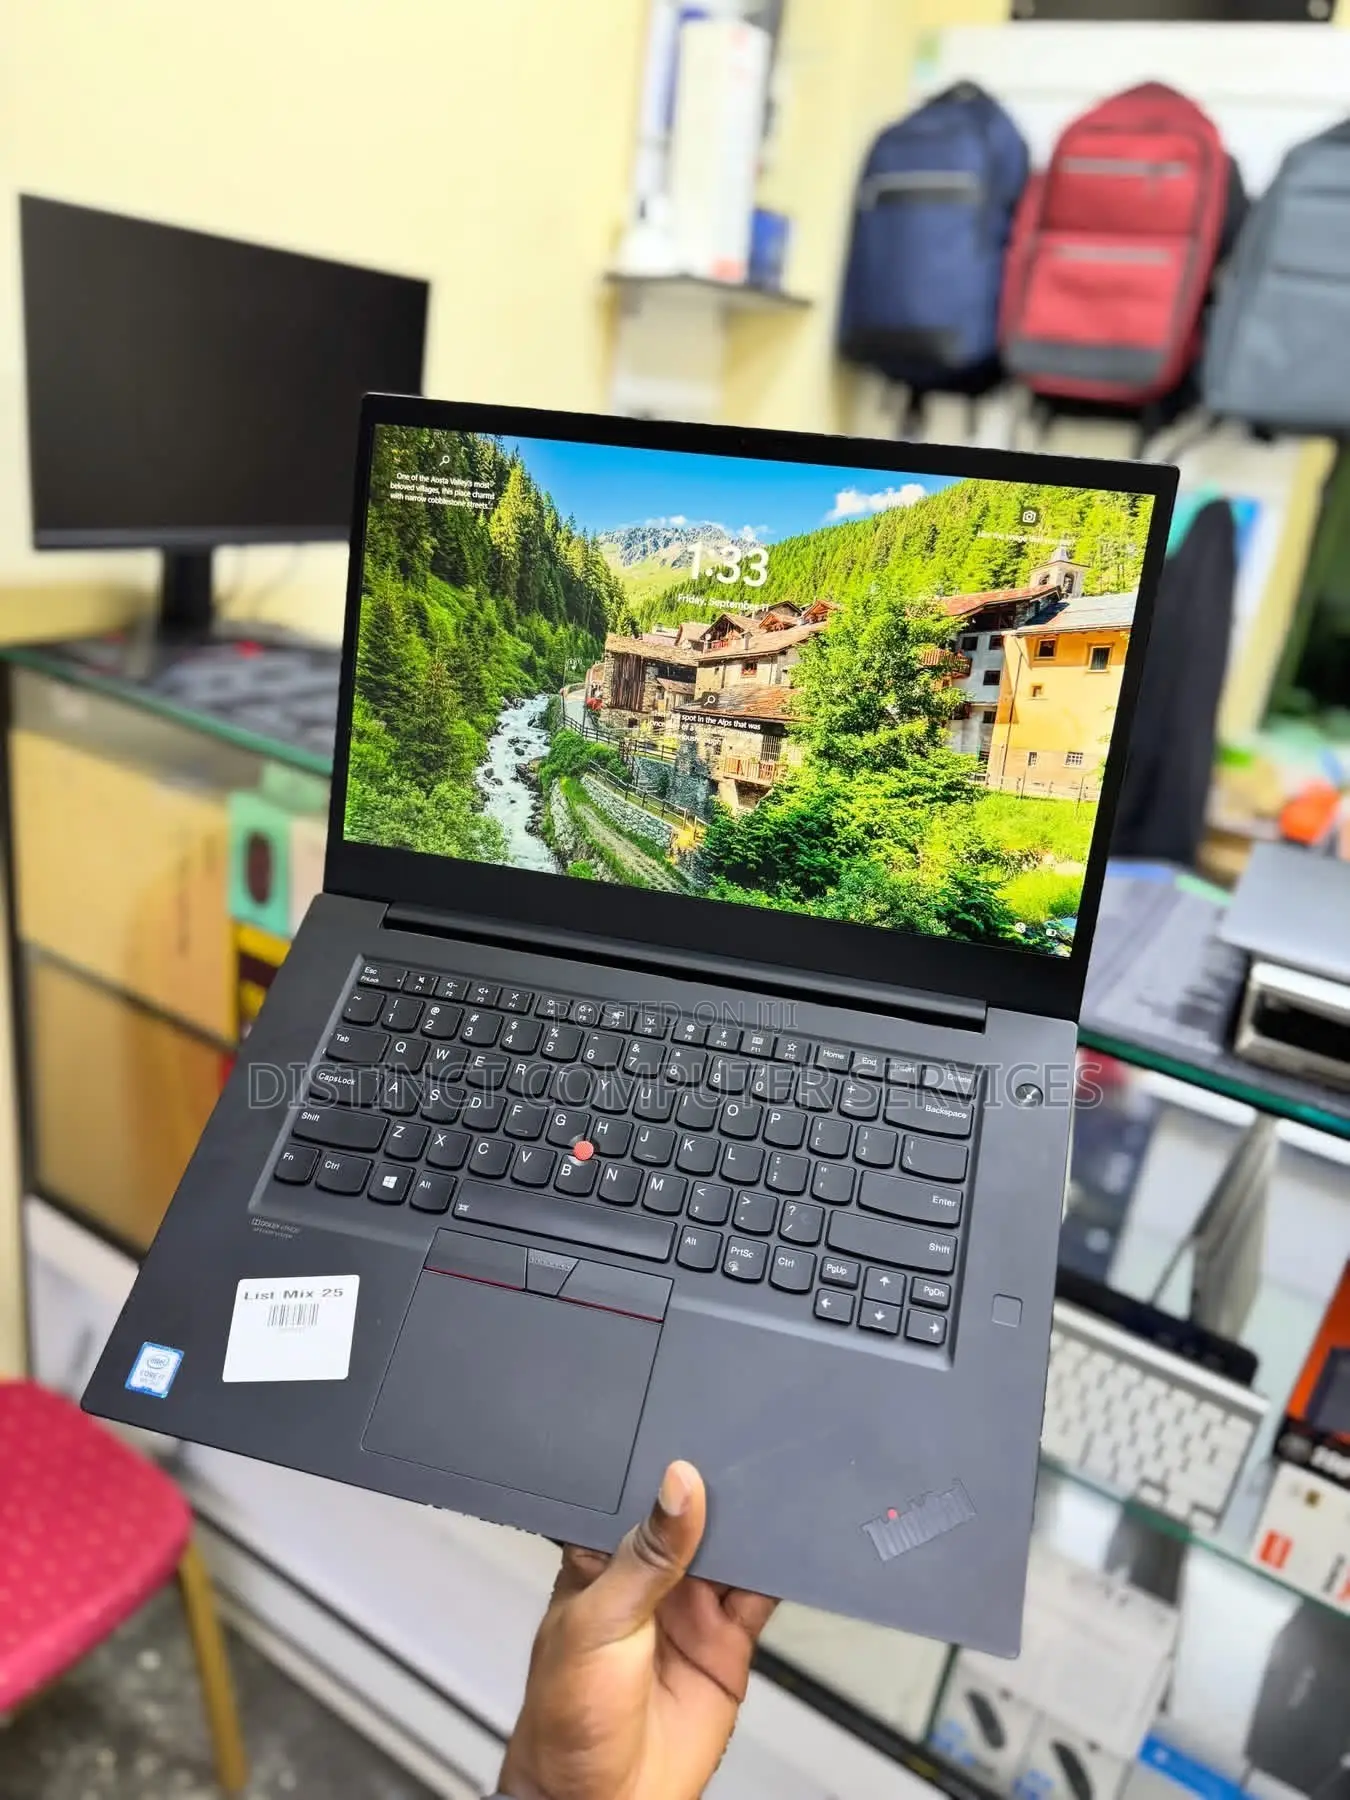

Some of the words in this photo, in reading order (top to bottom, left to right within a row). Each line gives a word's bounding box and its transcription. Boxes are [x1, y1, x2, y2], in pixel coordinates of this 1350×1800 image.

[397, 472, 410, 480] One
[419, 474, 429, 482] the
[431, 476, 448, 484] Aosta
[390, 482, 414, 491] beloved
[442, 487, 453, 495] this
[454, 489, 471, 498] place
[390, 492, 404, 500] with
[405, 494, 427, 502] narrow
[428, 496, 465, 507] cobblestone
[681, 714, 696, 722] spot
[705, 716, 717, 725] the
[717, 718, 732, 727] Alps
[733, 720, 747, 729] that
[364, 966, 377, 975] Esc
[424, 1019, 434, 1030] 2
[336, 1033, 350, 1043] Tab
[465, 1027, 473, 1037] 3
[505, 1034, 513, 1044] 4
[395, 1041, 407, 1053] Q
[546, 1041, 554, 1052] 5
[436, 1048, 450, 1060] W
[586, 1049, 596, 1060] 6
[822, 1050, 845, 1060] Home
[474, 1056, 486, 1067] E
[628, 1056, 637, 1067] 7
[862, 1057, 877, 1066] End
[515, 1063, 527, 1075] R
[669, 1065, 678, 1076] 8
[318, 1072, 356, 1086] CapsLock
[558, 1070, 568, 1082] T
[712, 1073, 721, 1084] 9
[388, 1081, 398, 1094] A
[600, 1079, 610, 1091] Y
[755, 1081, 763, 1092] 0
[430, 1089, 440, 1101] S
[641, 1087, 651, 1100] U
[470, 1096, 482, 1109] D
[512, 1104, 523, 1116] F
[727, 1104, 739, 1117] O
[925, 1104, 968, 1119] Backspace
[301, 1111, 320, 1122] Shift
[555, 1113, 567, 1126] G
[770, 1112, 781, 1124] P
[392, 1125, 406, 1138] Z
[597, 1121, 609, 1135] H
[434, 1133, 447, 1147] X
[640, 1130, 649, 1143] J
[477, 1142, 489, 1155] C
[683, 1138, 695, 1152] K
[283, 1152, 294, 1161] Fn
[522, 1150, 532, 1163] V
[727, 1147, 736, 1161] L
[324, 1160, 340, 1171] Ctrl
[561, 1163, 572, 1176] B
[606, 1167, 618, 1181] N
[419, 1179, 431, 1189] Alt
[650, 1177, 665, 1192] M
[932, 1195, 956, 1208] Enter
[685, 1236, 697, 1246] Alt
[731, 1246, 754, 1259] PrtSc
[929, 1242, 951, 1254] Shift
[777, 1256, 795, 1268] Ctrl
[826, 1263, 847, 1276] PgUp
[244, 1291, 274, 1301] List
[283, 1289, 314, 1300] Mix
[322, 1288, 344, 1298] 25
[923, 1286, 946, 1298] PgDn
